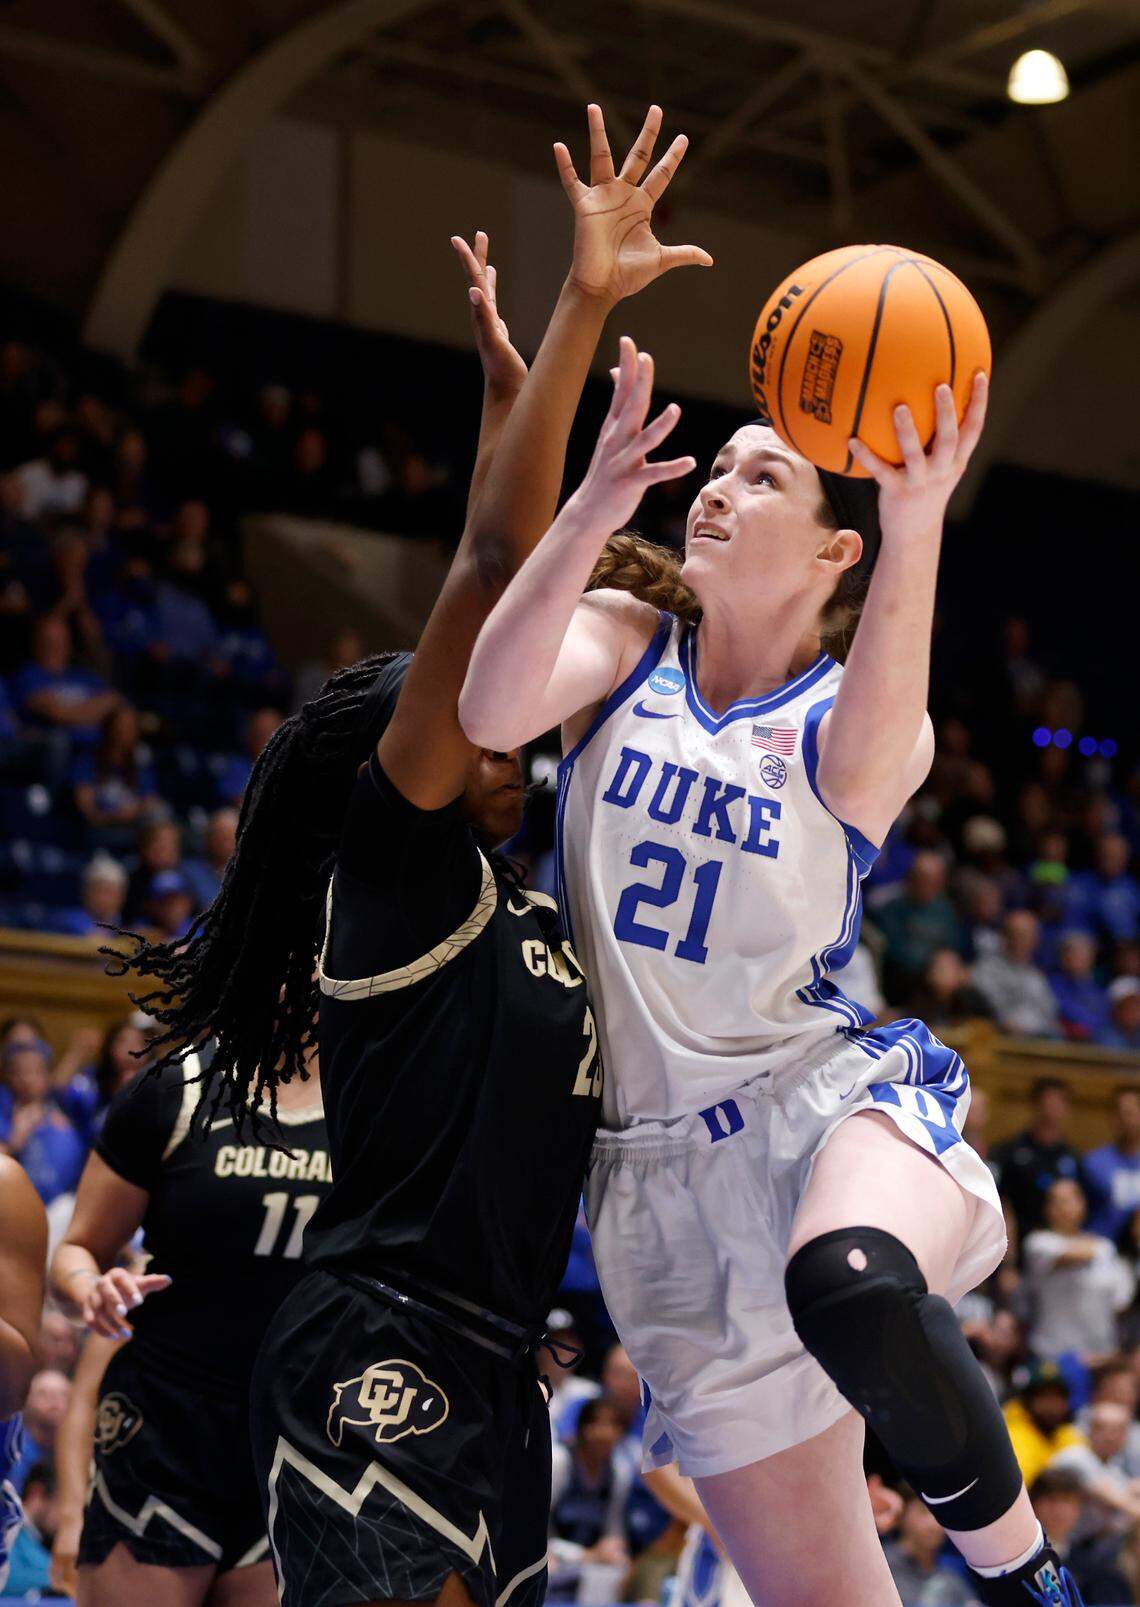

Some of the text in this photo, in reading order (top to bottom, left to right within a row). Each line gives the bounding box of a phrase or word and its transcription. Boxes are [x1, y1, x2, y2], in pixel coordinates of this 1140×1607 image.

[651, 675, 680, 692] NCAA
[602, 747, 782, 859] DUKE
[614, 840, 723, 965] 21
[571, 1005, 604, 1098] 2
[697, 1098, 745, 1144] D
[214, 1145, 333, 1183] COLORA
[253, 1191, 320, 1259] 11
[357, 1368, 418, 1425] CU
